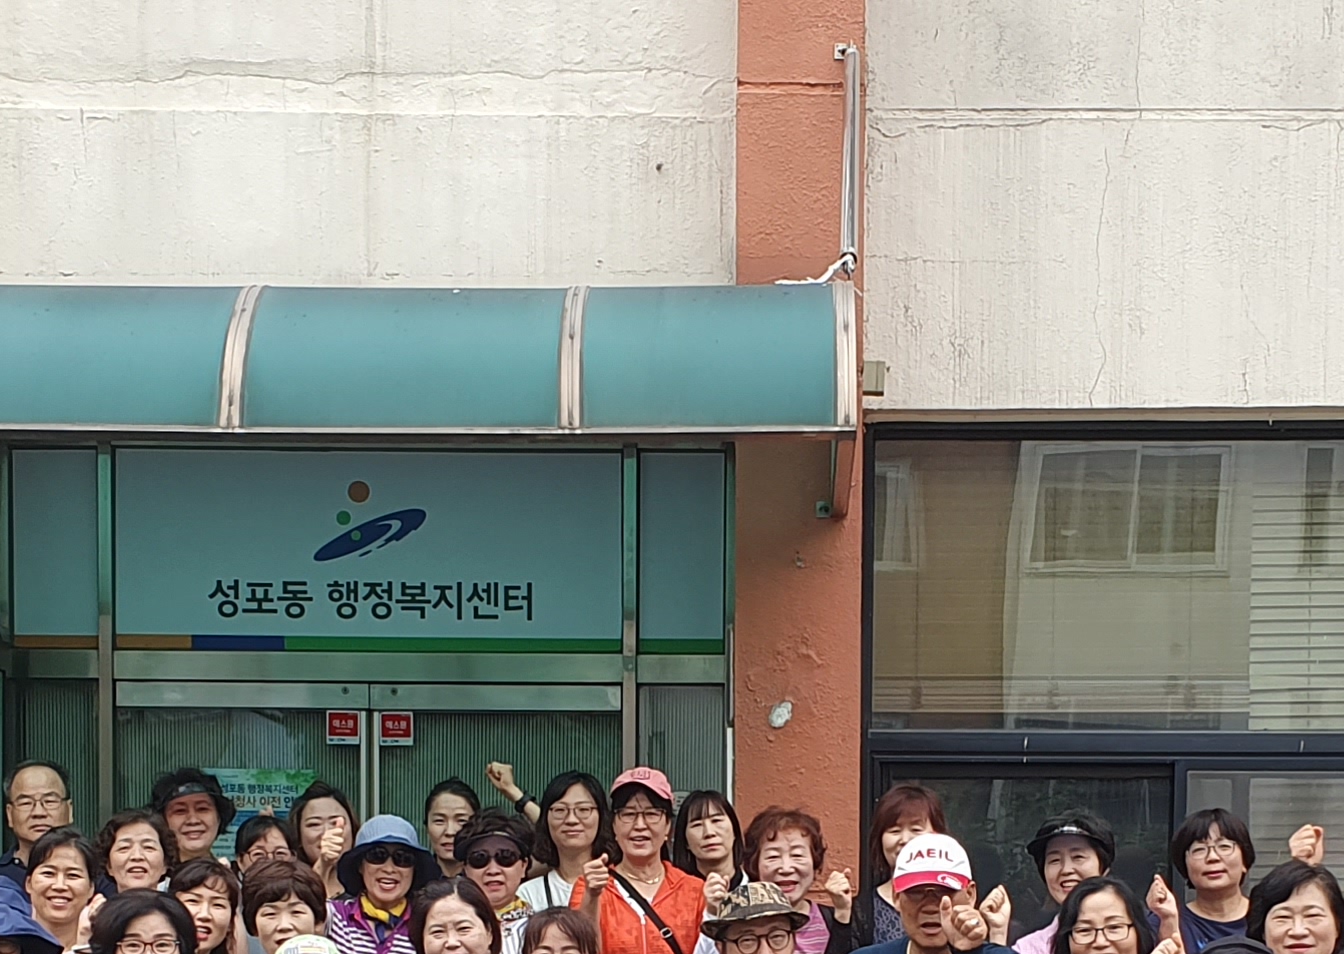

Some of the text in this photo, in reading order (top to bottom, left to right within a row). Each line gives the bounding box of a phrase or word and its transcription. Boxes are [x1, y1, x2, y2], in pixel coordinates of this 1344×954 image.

[208, 579, 533, 621] 성포동 행정복지센터
[247, 784, 299, 794] 행정복지센터
[230, 796, 296, 808] 청사 이전 안
[905, 848, 954, 864] JAEIL
